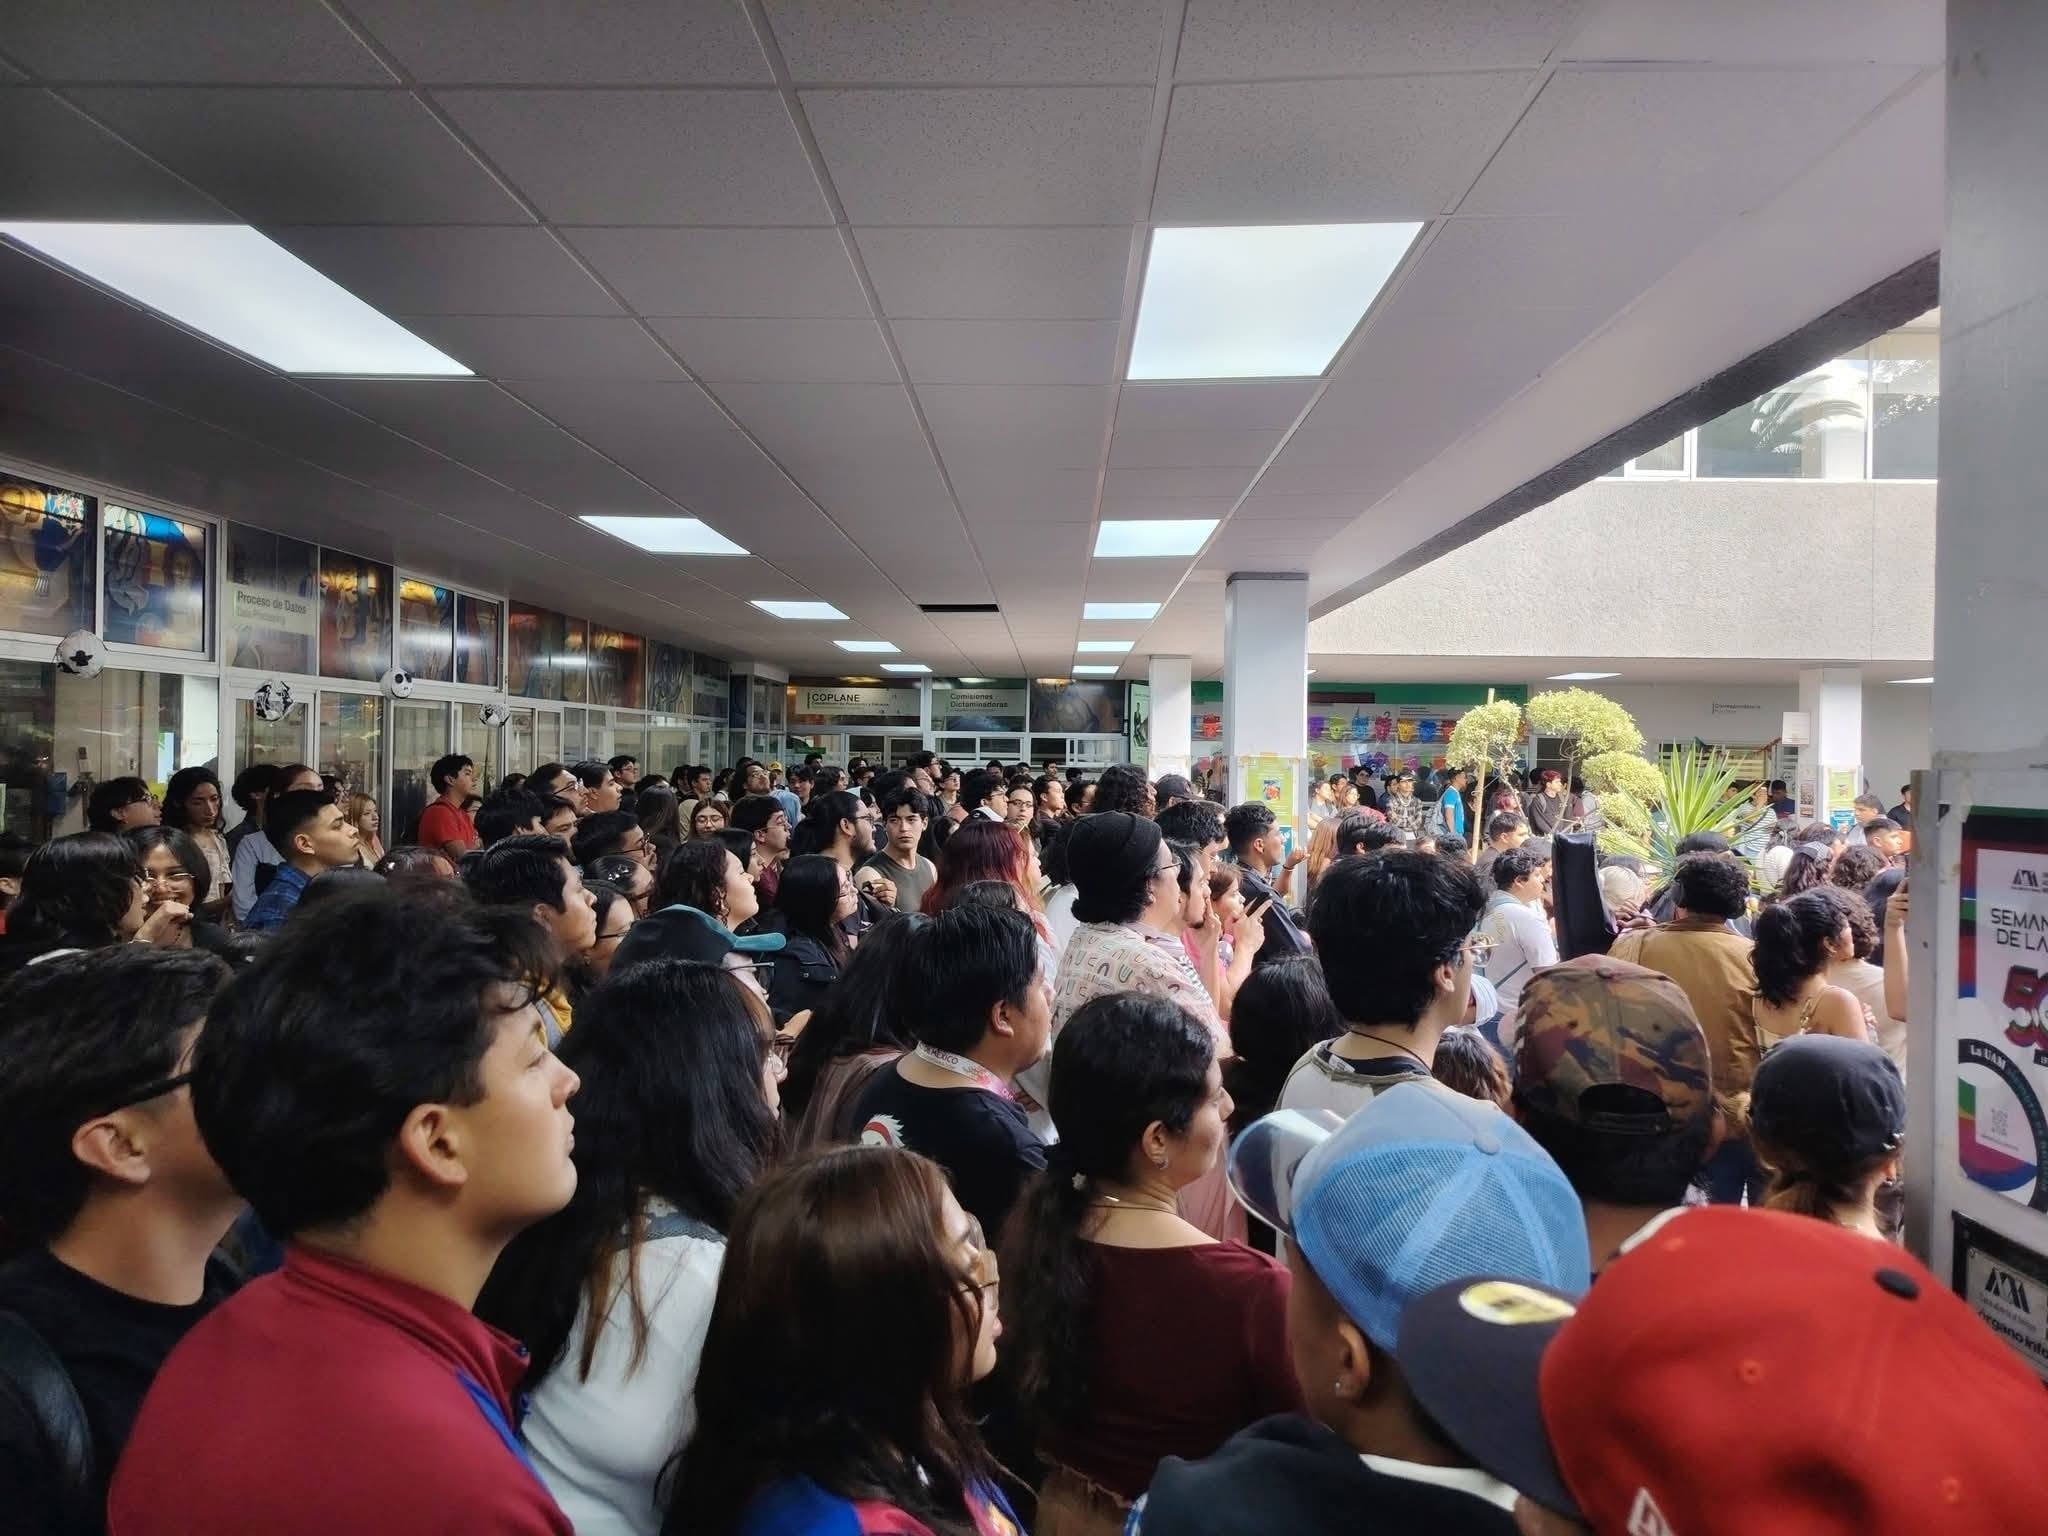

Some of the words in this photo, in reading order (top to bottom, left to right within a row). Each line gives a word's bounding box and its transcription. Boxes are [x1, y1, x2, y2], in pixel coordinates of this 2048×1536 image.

[237, 590, 271, 608] Proceso
[272, 599, 283, 609] de
[284, 600, 307, 614] Datos
[812, 693, 861, 702] COPLANE
[1996, 928, 2021, 948] DE
[2025, 933, 2048, 953] LA
[1970, 1044, 1982, 1057] La
[1984, 1048, 2007, 1070] UAM
